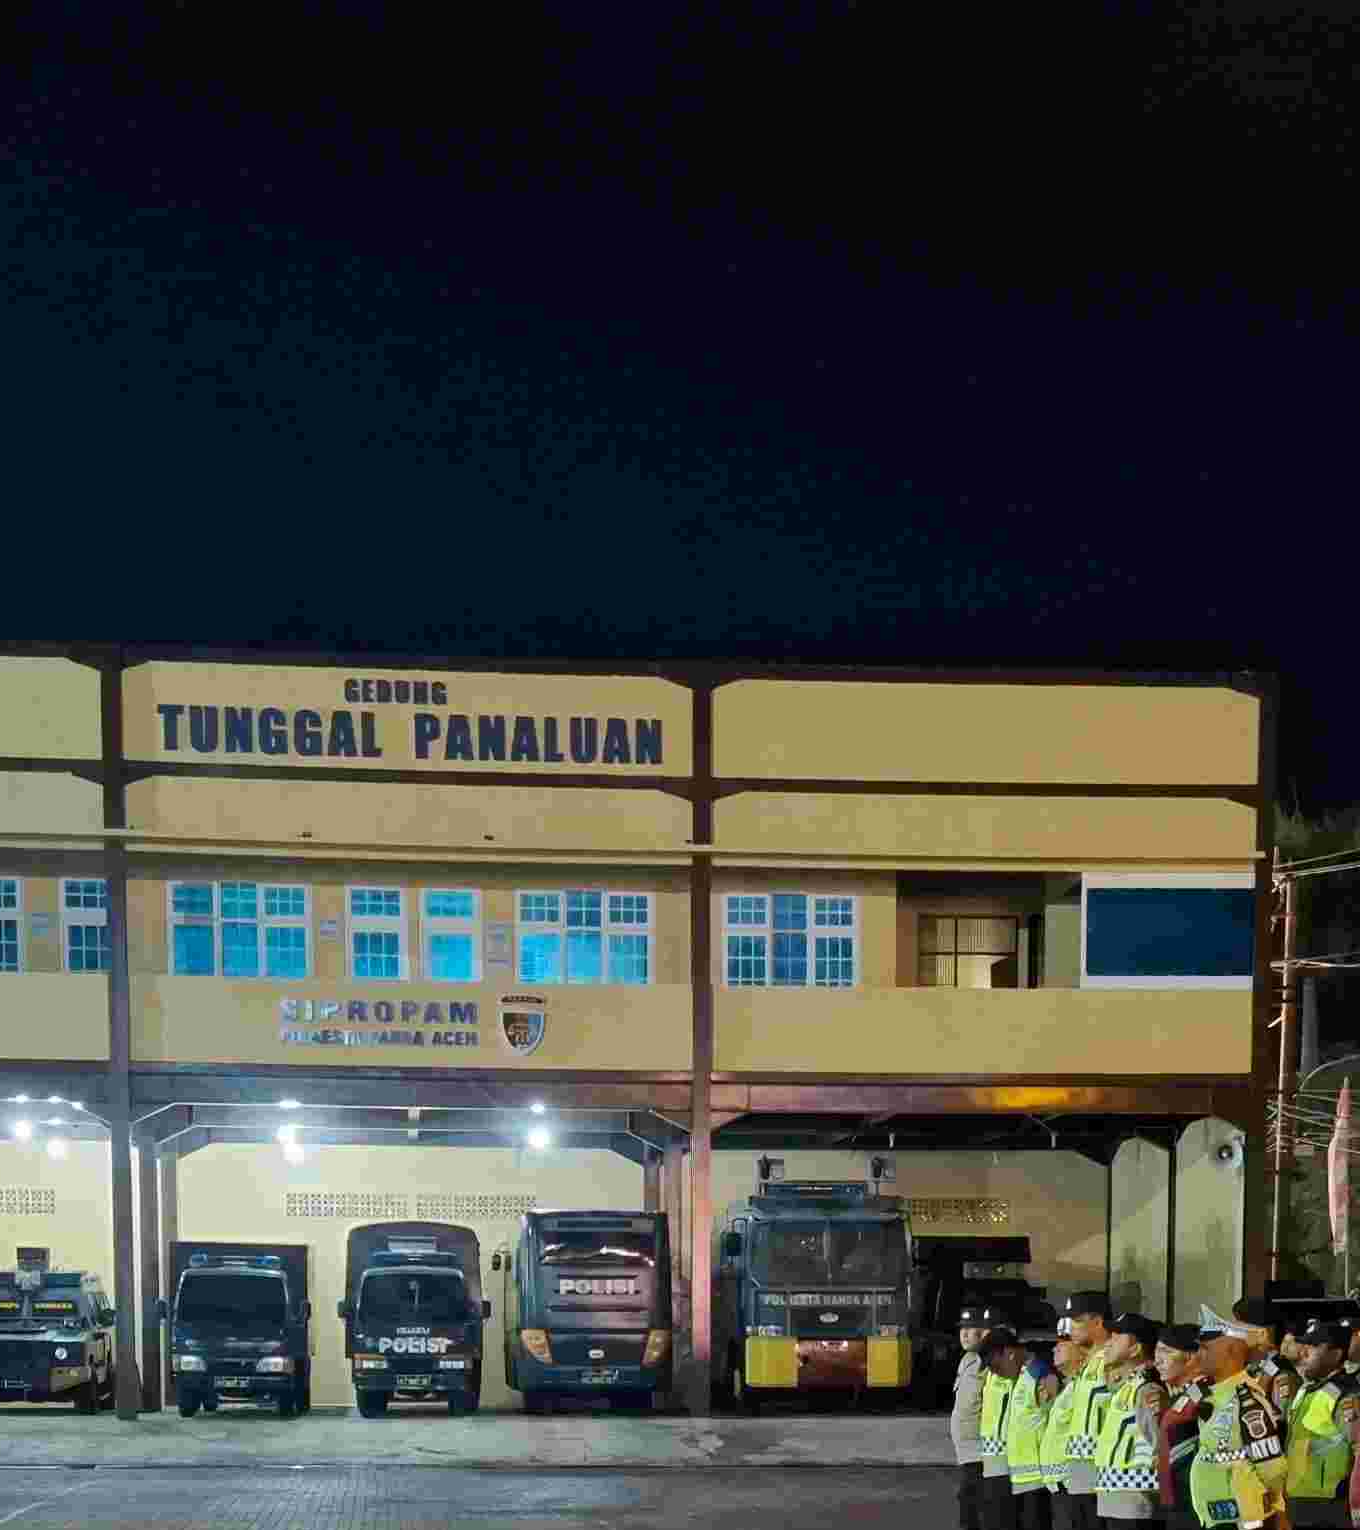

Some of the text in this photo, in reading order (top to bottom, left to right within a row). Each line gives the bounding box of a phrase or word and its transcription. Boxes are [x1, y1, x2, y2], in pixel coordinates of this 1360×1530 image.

[344, 679, 448, 706] GEDUNG
[157, 704, 664, 765] TUNGGAL PANALUAN
[559, 1279, 637, 1296] POLISI
